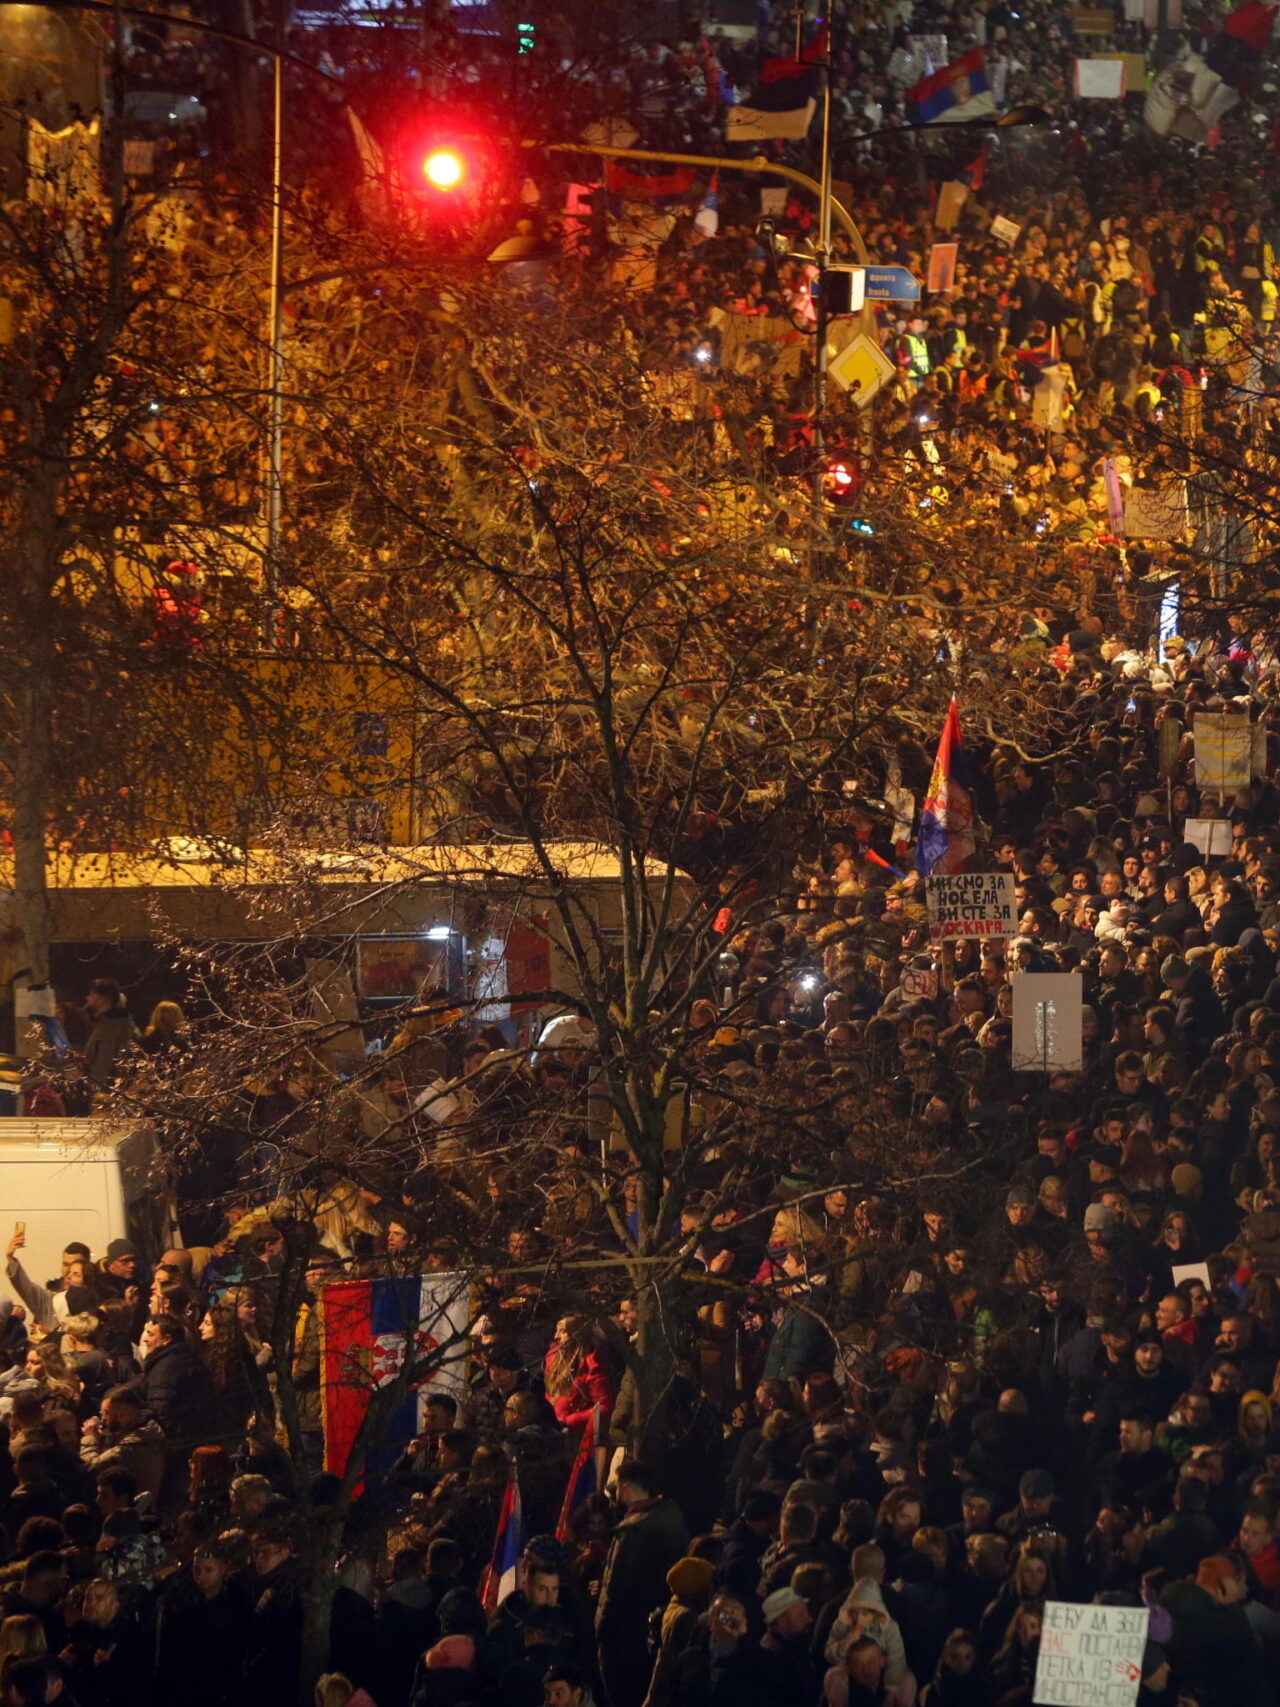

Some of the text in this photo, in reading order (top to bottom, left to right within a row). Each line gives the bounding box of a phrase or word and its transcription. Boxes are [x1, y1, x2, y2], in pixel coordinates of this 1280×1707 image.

[929, 875, 1005, 890] МИ СМО ЗА
[938, 905, 1011, 920] ВИ СТЕ ЗА
[1090, 1611, 1108, 1632] ДА
[1041, 1628, 1072, 1654] ВАС
